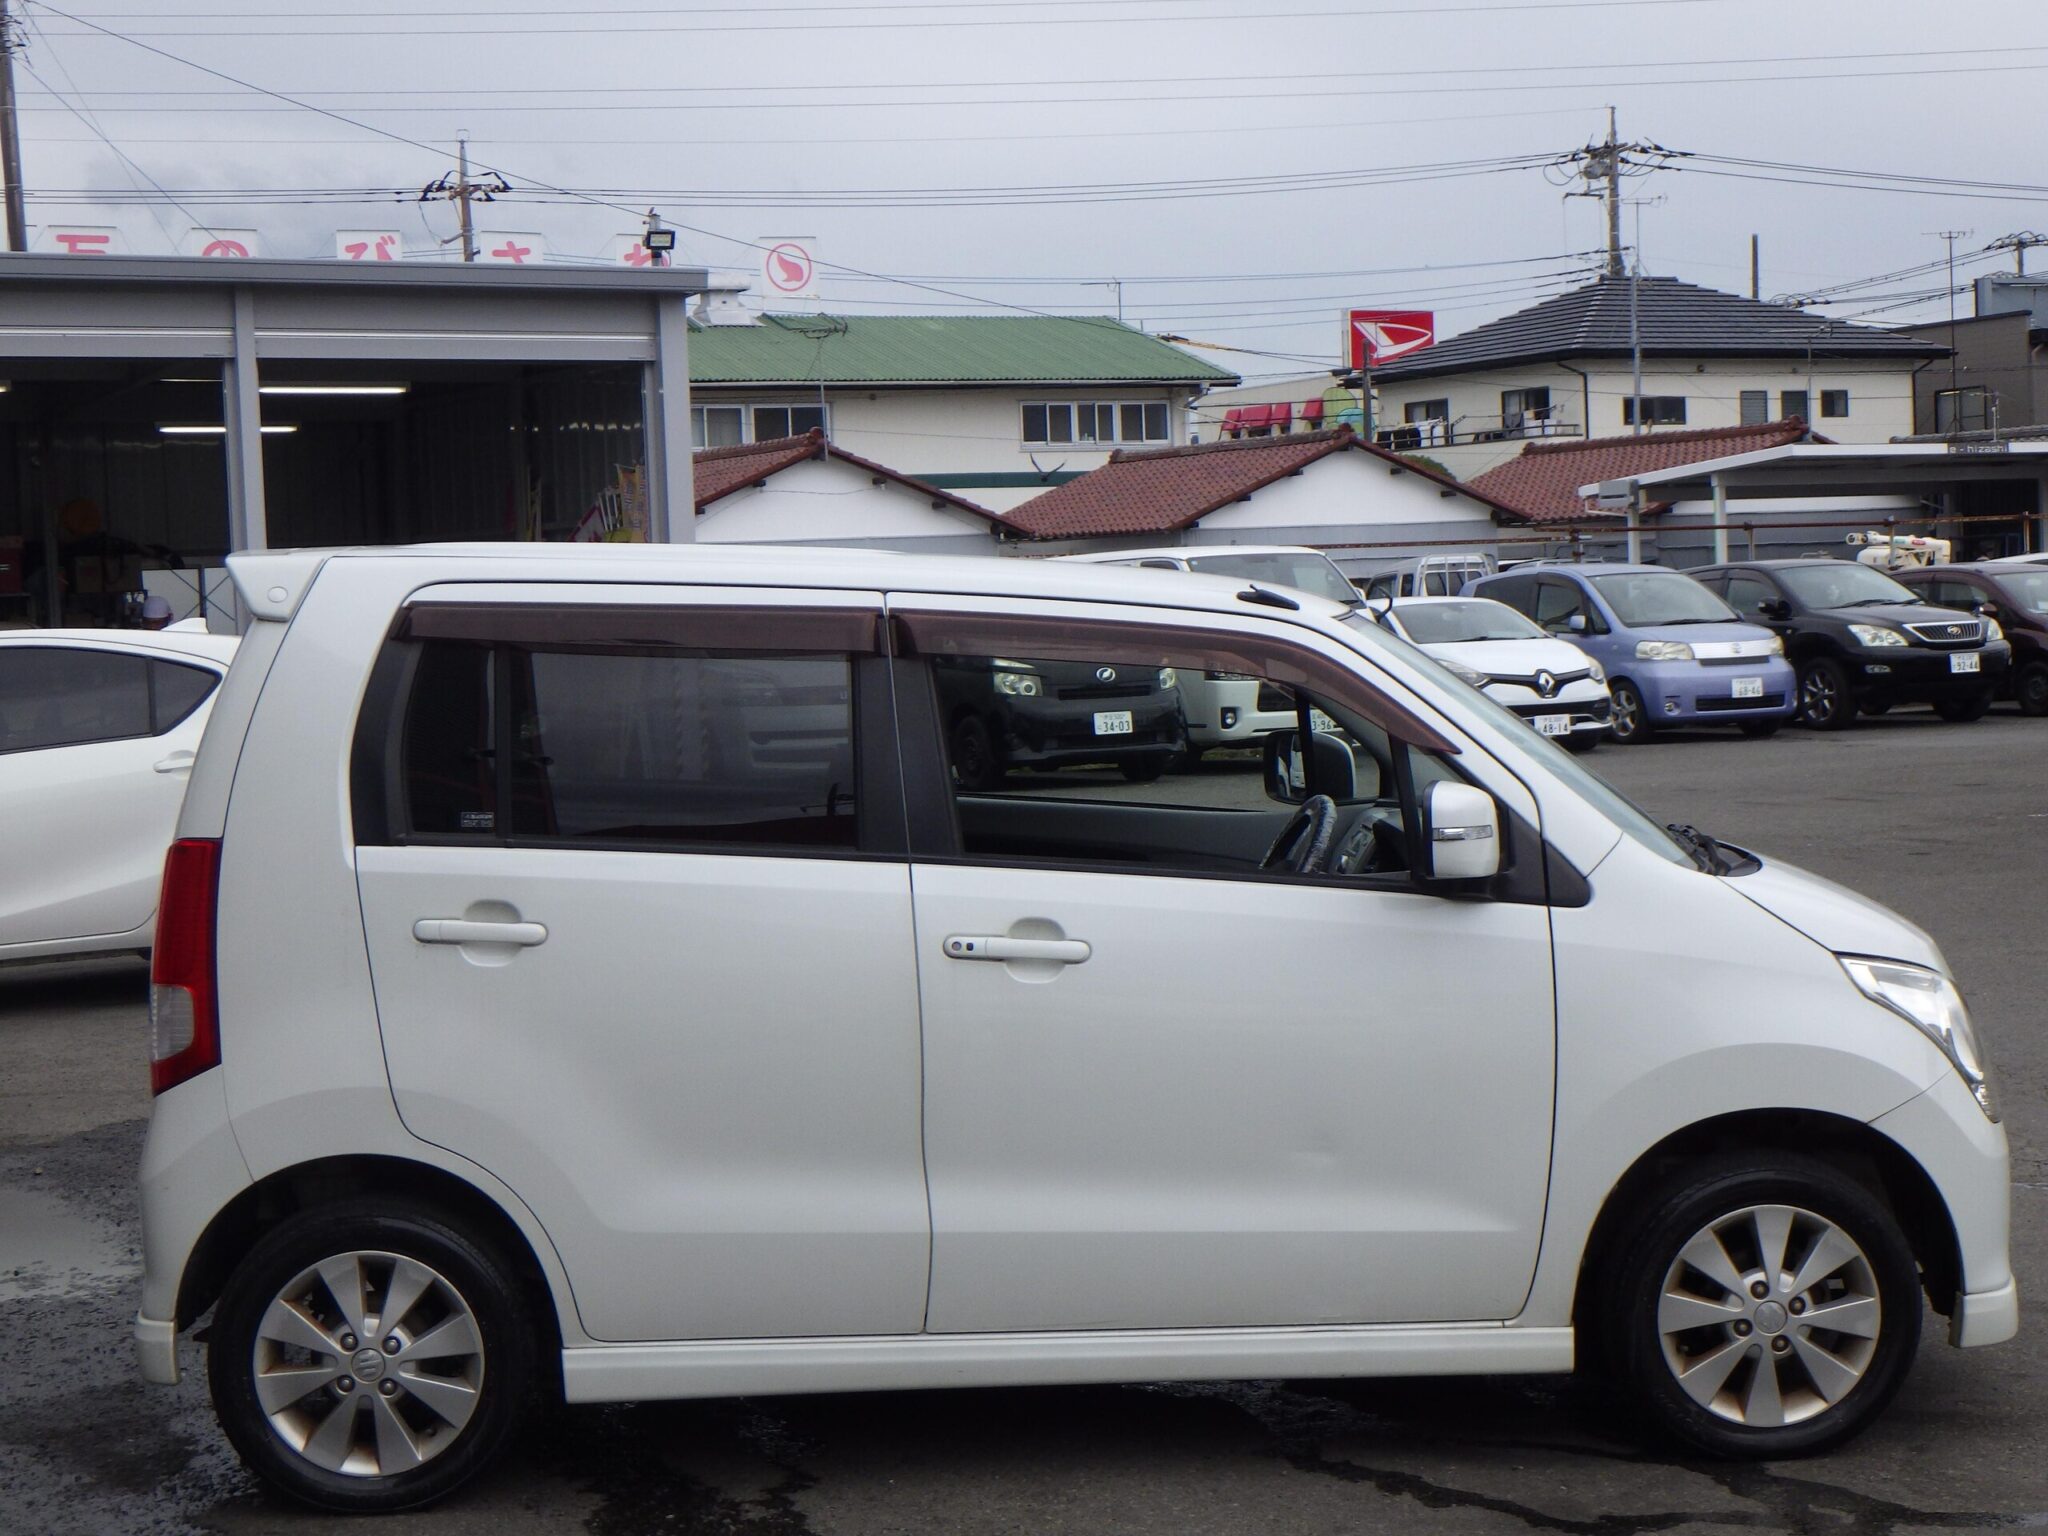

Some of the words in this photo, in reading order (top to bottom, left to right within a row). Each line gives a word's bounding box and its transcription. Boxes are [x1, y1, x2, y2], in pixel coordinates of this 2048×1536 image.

[1103, 720, 1130, 732] 34-03
[1312, 719, 1332, 731] 3-96
[1543, 722, 1568, 734] 48-14
